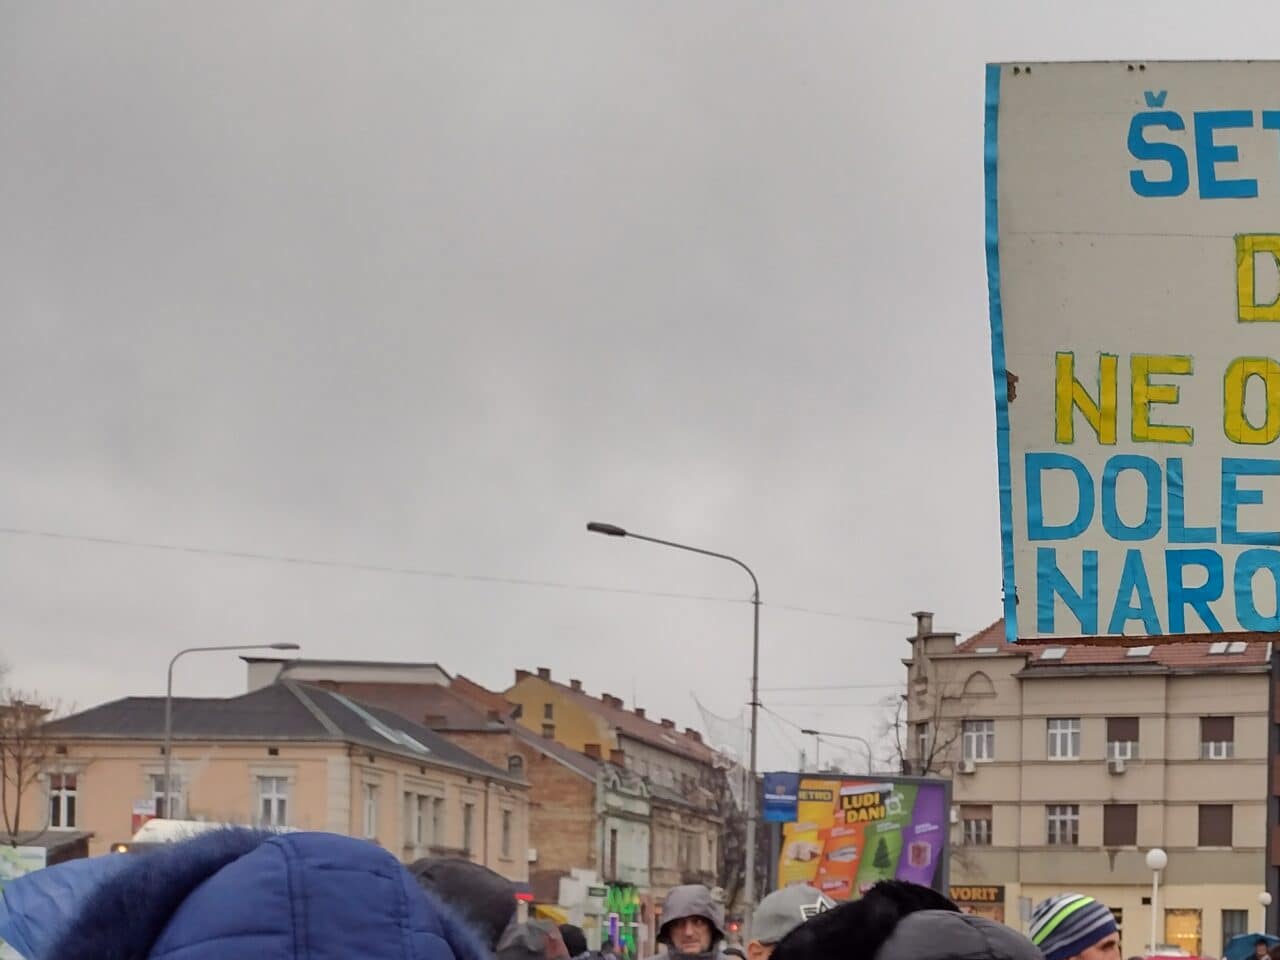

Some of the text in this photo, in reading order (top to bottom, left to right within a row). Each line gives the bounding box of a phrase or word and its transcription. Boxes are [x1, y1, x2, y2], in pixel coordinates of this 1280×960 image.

[1055, 351, 1193, 446] NE
[1025, 453, 1280, 546] DOLE
[847, 806, 885, 824] DANI
